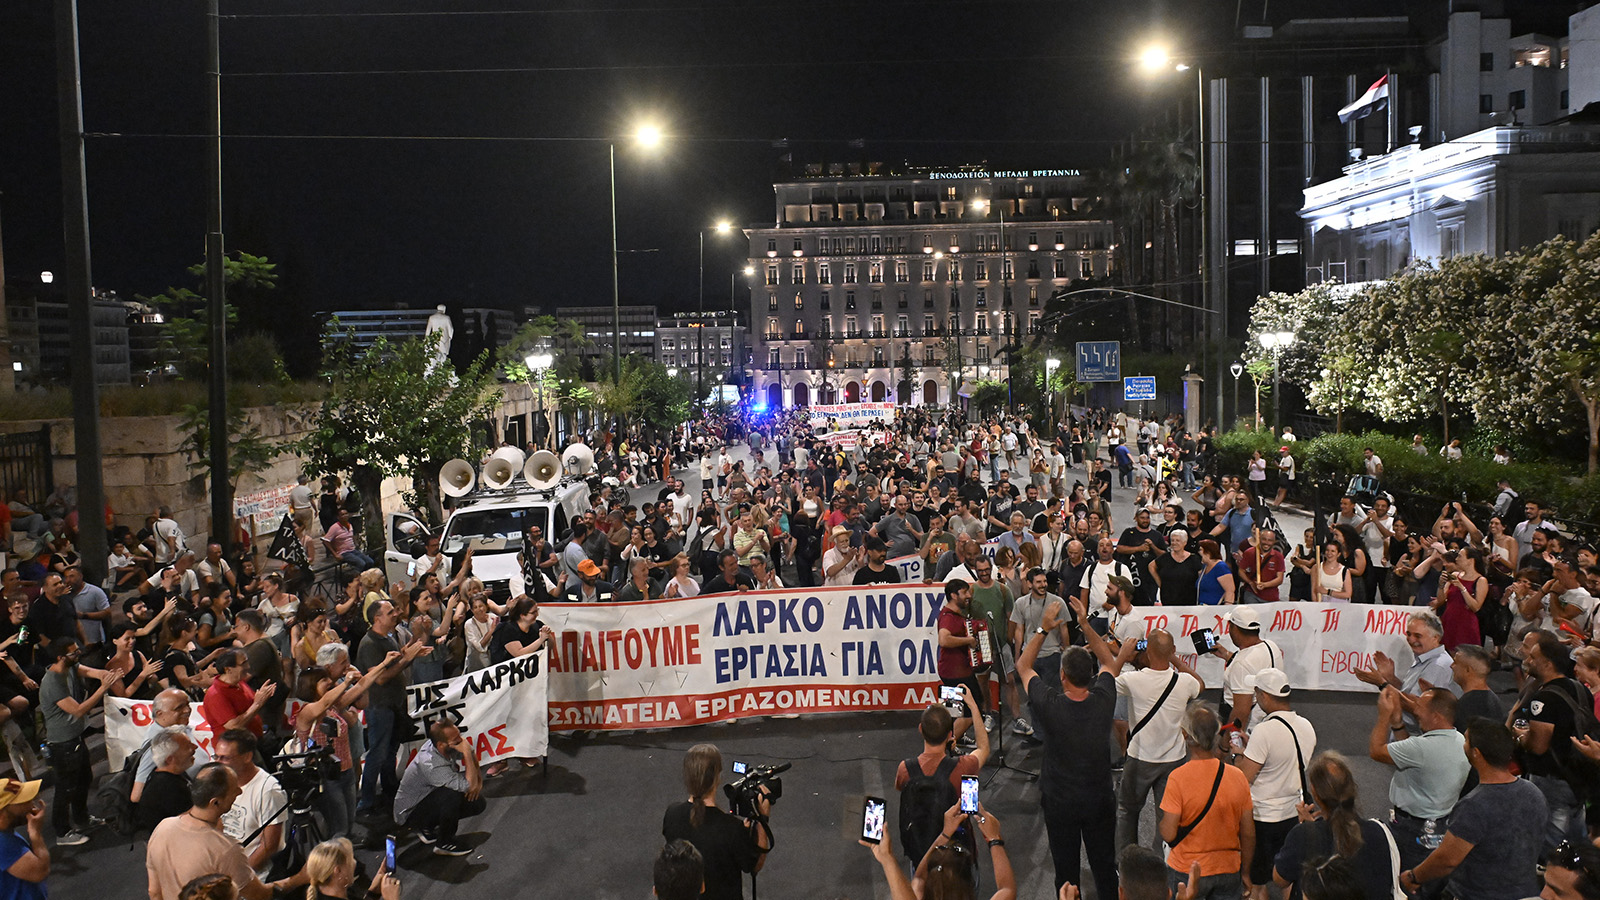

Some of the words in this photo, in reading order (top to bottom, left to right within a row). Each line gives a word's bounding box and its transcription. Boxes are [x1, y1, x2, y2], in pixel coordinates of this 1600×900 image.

[1033, 169, 1080, 178] ΒΡΕΤΑΝΝΙΑ
[712, 596, 824, 637] ΛΑΡΚΟ
[842, 592, 946, 630] ΑΝΟΙΧ
[1180, 614, 1199, 638] ΤΑ
[1269, 608, 1303, 633] ΑΠΟ
[1320, 608, 1341, 633] ΤΗ
[548, 624, 702, 672] ΑΠΑΙΤΟΥΜΕ
[714, 643, 827, 684] ΕΡΓΑΣΙΑ
[841, 640, 884, 677] ΓΙΑ
[898, 638, 940, 675] ΟΛ
[1321, 649, 1375, 675] ΕΥΒΟΙΑ
[460, 654, 540, 699] ΛΑΡΚΟ
[549, 701, 681, 726] ΣΩΜΑΤΕΙΑ
[695, 688, 889, 719] ΕΡΓΑΖΟΜΕΝΩΝ
[903, 686, 940, 705] ΛΑ
